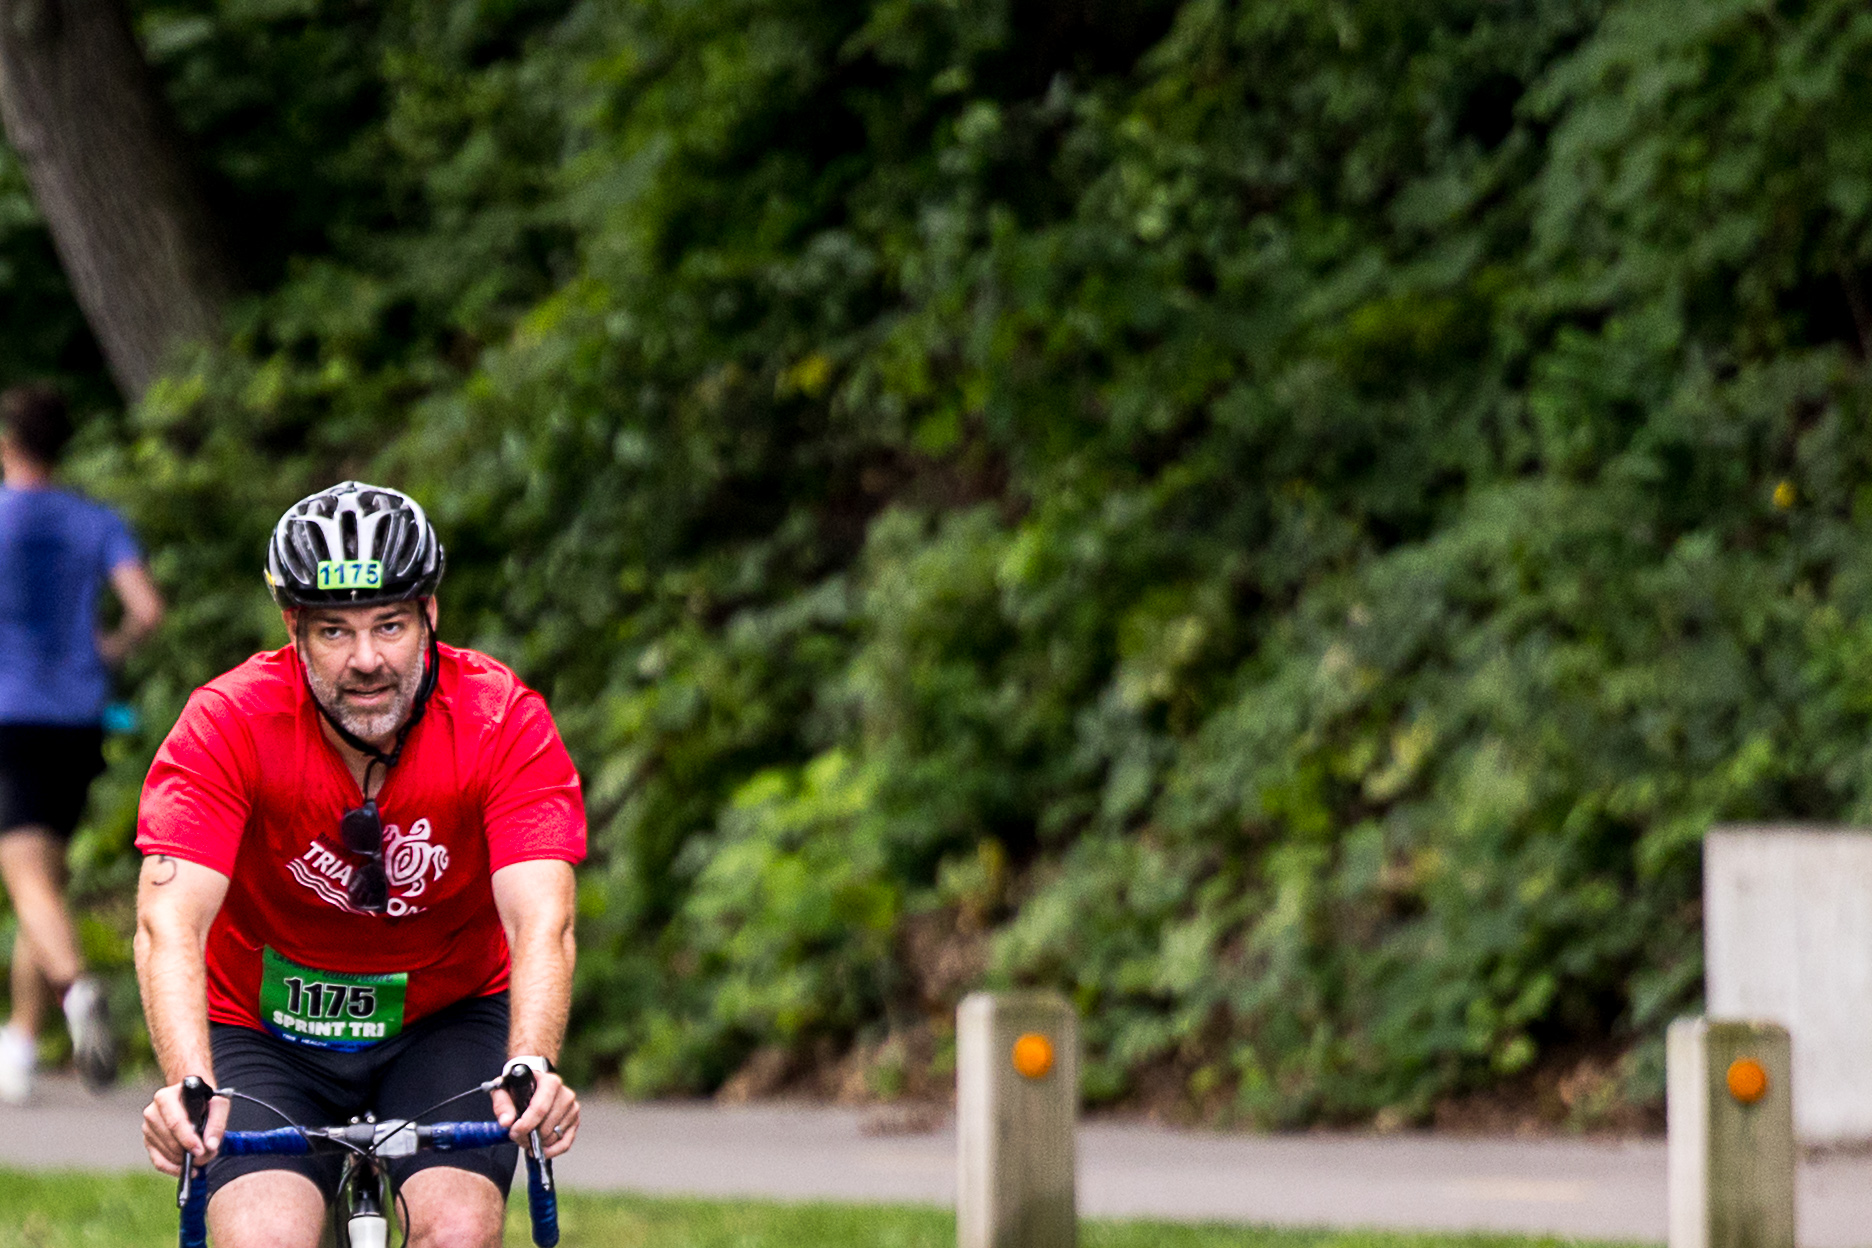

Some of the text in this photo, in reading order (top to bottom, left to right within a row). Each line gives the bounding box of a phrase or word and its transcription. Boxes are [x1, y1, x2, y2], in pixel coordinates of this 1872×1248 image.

[320, 563, 379, 585] 1175
[284, 976, 376, 1018] 1175
[272, 1010, 386, 1037] SPRINT TRI
